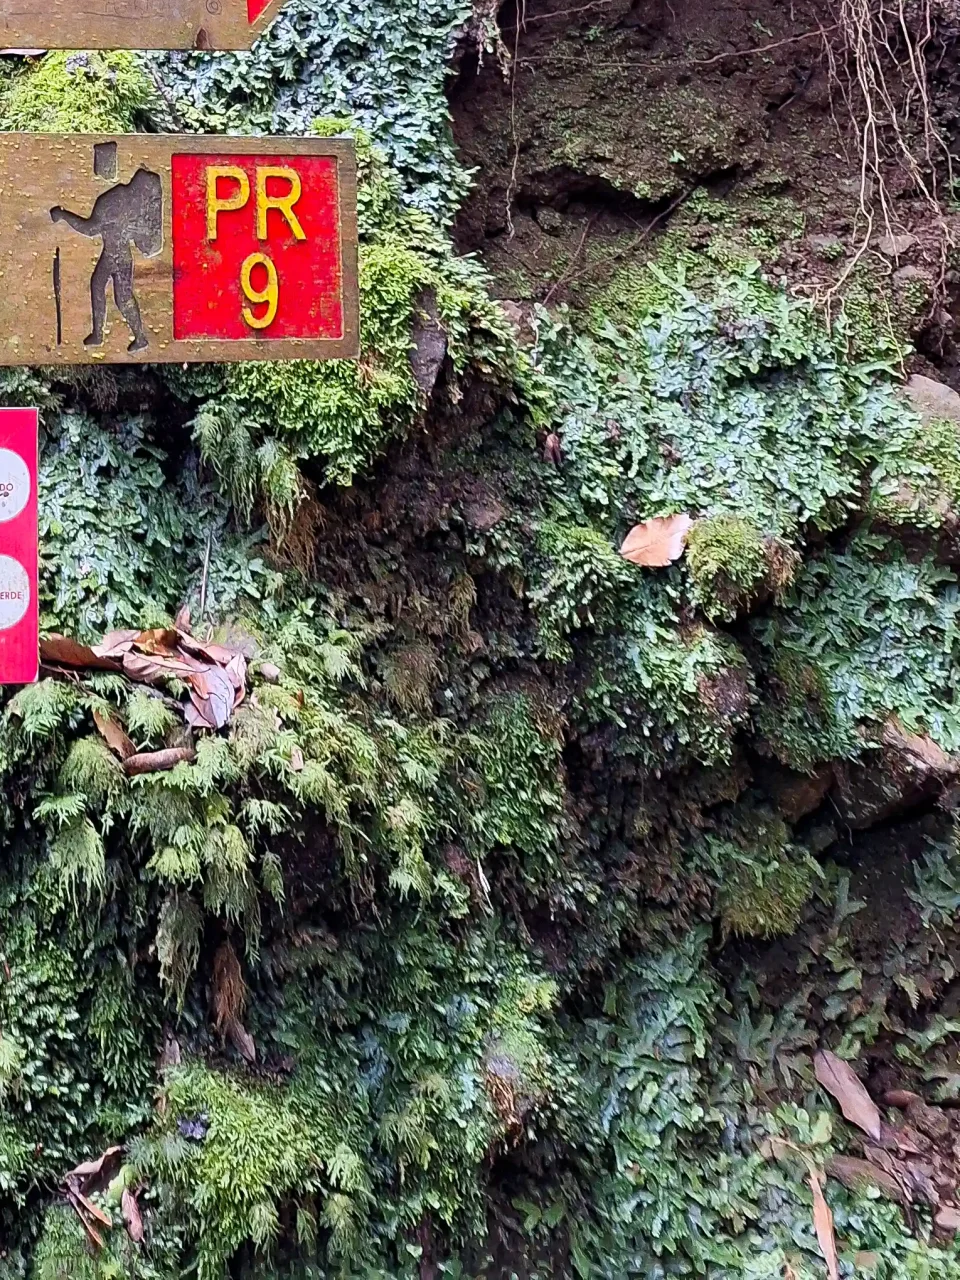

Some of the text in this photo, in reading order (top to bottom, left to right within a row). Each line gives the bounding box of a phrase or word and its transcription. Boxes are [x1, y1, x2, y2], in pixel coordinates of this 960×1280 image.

[206, 166, 306, 241] PR
[240, 252, 279, 329] 9
[0, 483, 14, 492] DO
